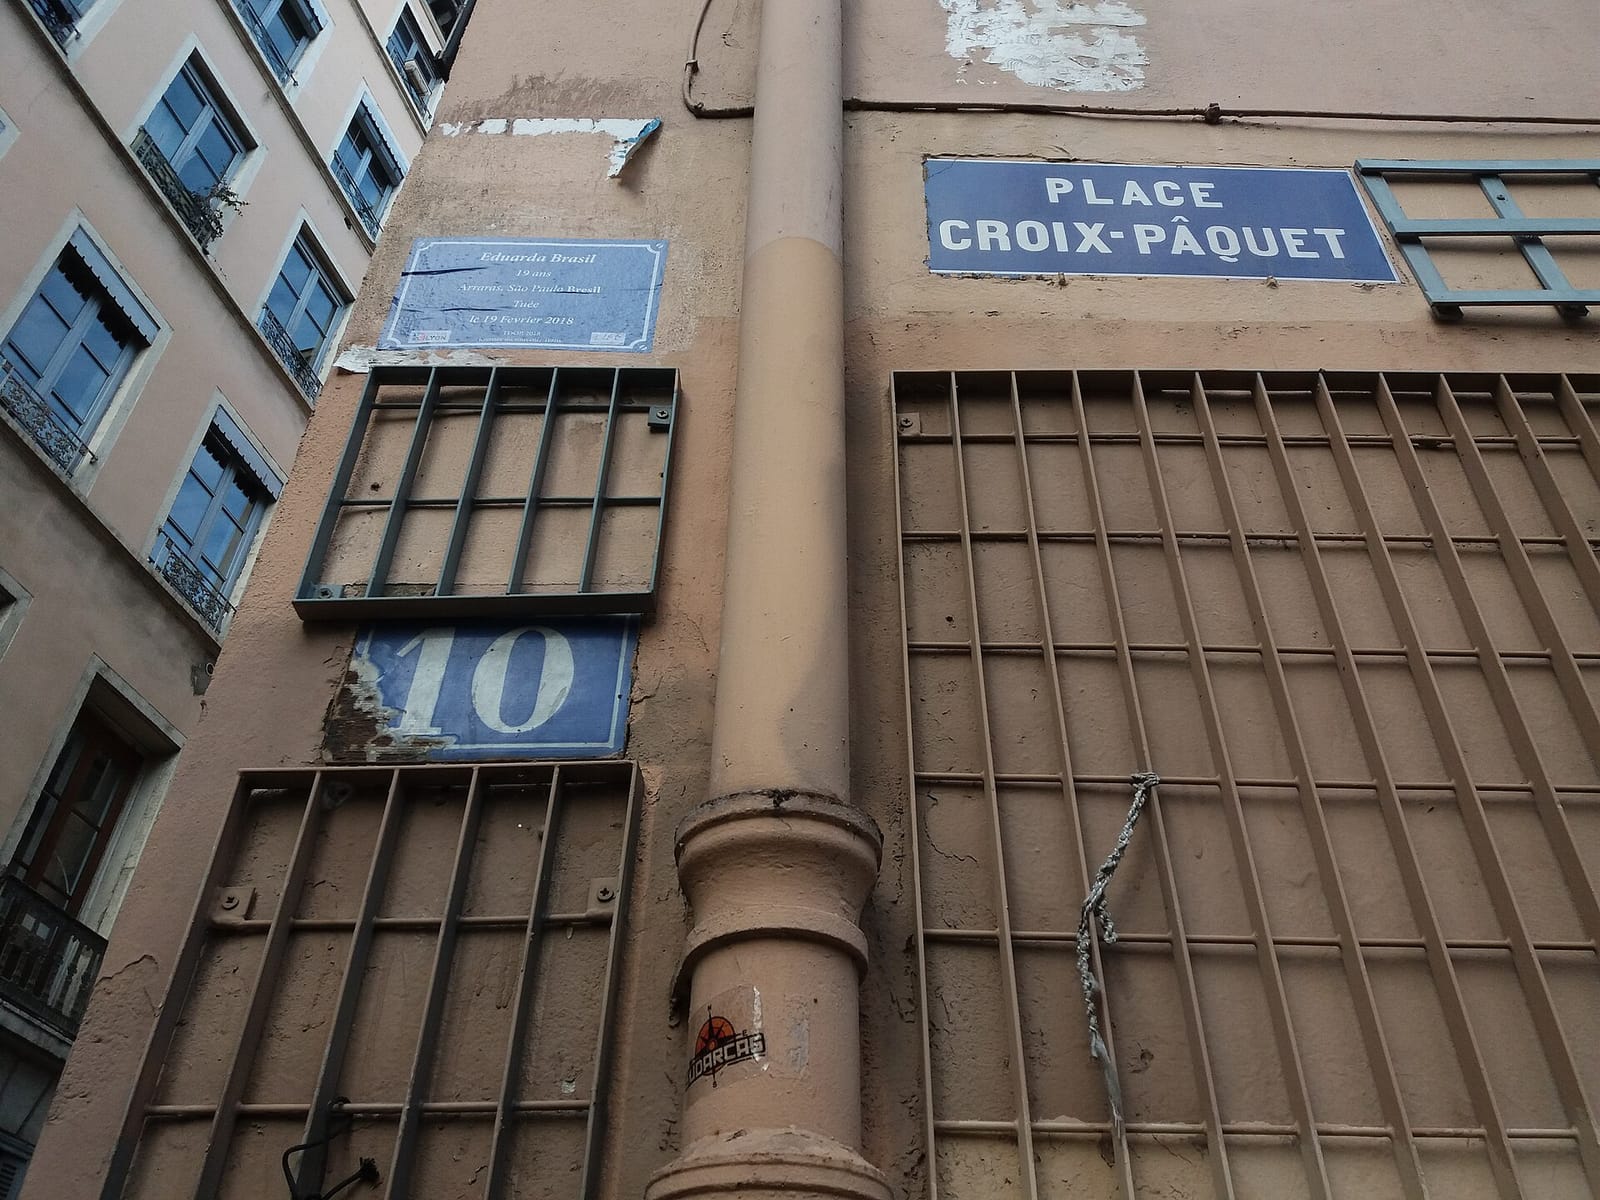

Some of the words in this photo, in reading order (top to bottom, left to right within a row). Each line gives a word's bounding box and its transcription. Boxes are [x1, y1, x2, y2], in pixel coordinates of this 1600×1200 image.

[1045, 177, 1224, 209] PLACE
[939, 215, 1346, 263] CROIX-PÂQUET
[480, 252, 546, 263] Eduarda
[550, 253, 597, 264] Brasil
[515, 269, 530, 277] 19
[532, 270, 552, 278] ans
[531, 284, 564, 293] Paulo
[469, 315, 479, 324] le
[484, 315, 499, 324] 19
[544, 316, 575, 325] 2018
[388, 625, 575, 733] 10
